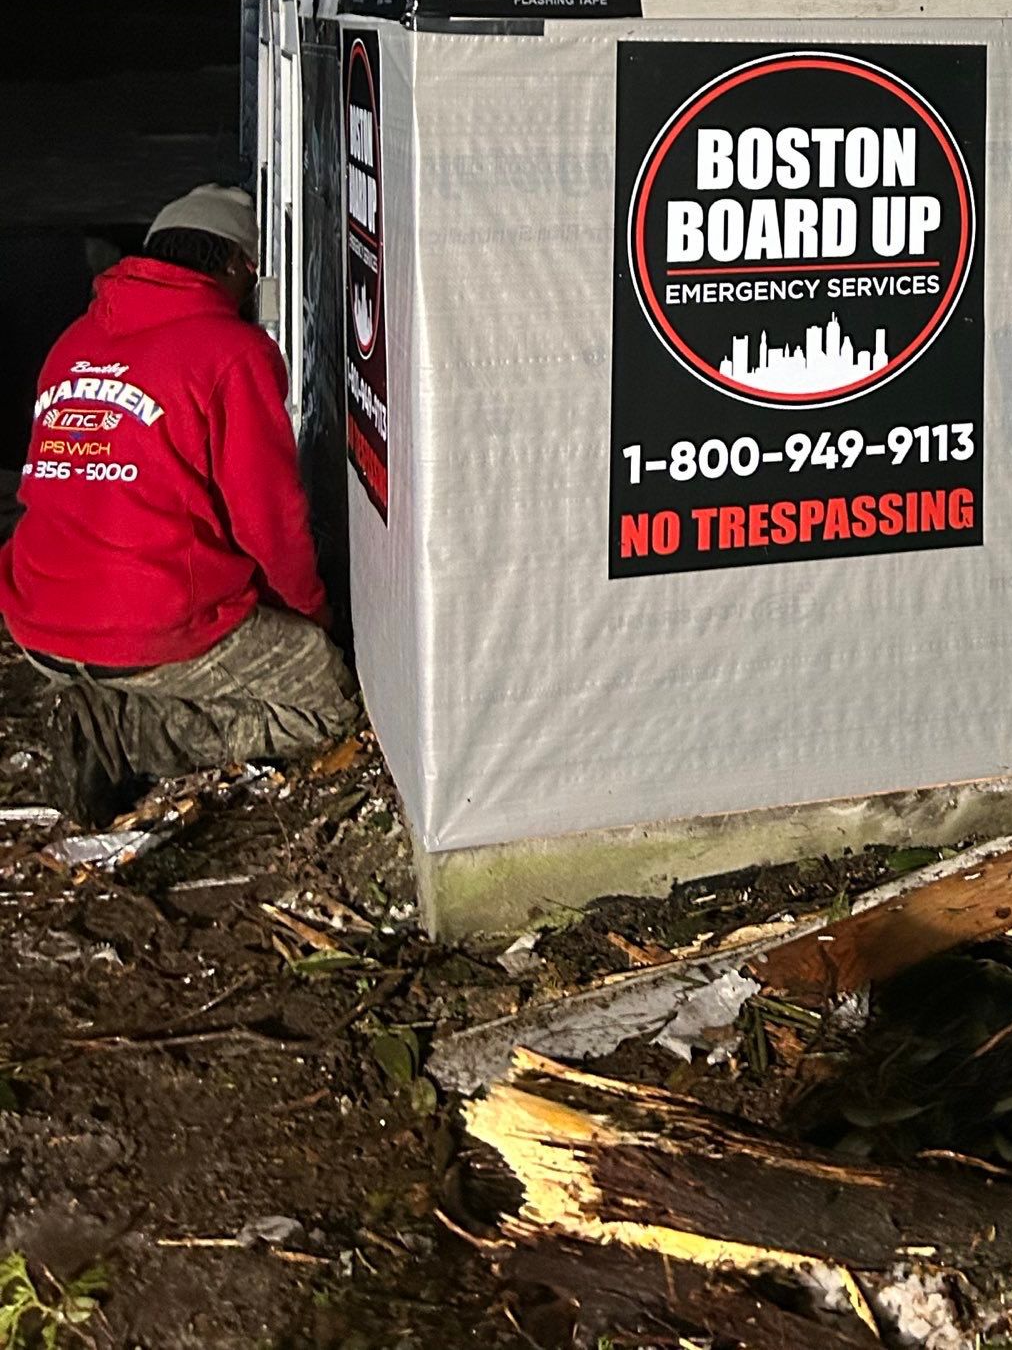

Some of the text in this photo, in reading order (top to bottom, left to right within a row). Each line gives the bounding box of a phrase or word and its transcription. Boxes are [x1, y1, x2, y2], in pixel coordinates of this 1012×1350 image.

[697, 127, 916, 190] BOSTON
[667, 195, 941, 263] BOARD UP
[665, 275, 940, 305] EMERGENCY SERVICES
[34, 378, 165, 427] WARREN
[40, 440, 111, 456] IPSWICH
[622, 422, 975, 485] 1-800-949-9113
[620, 487, 974, 559] NO TRESPASSING
